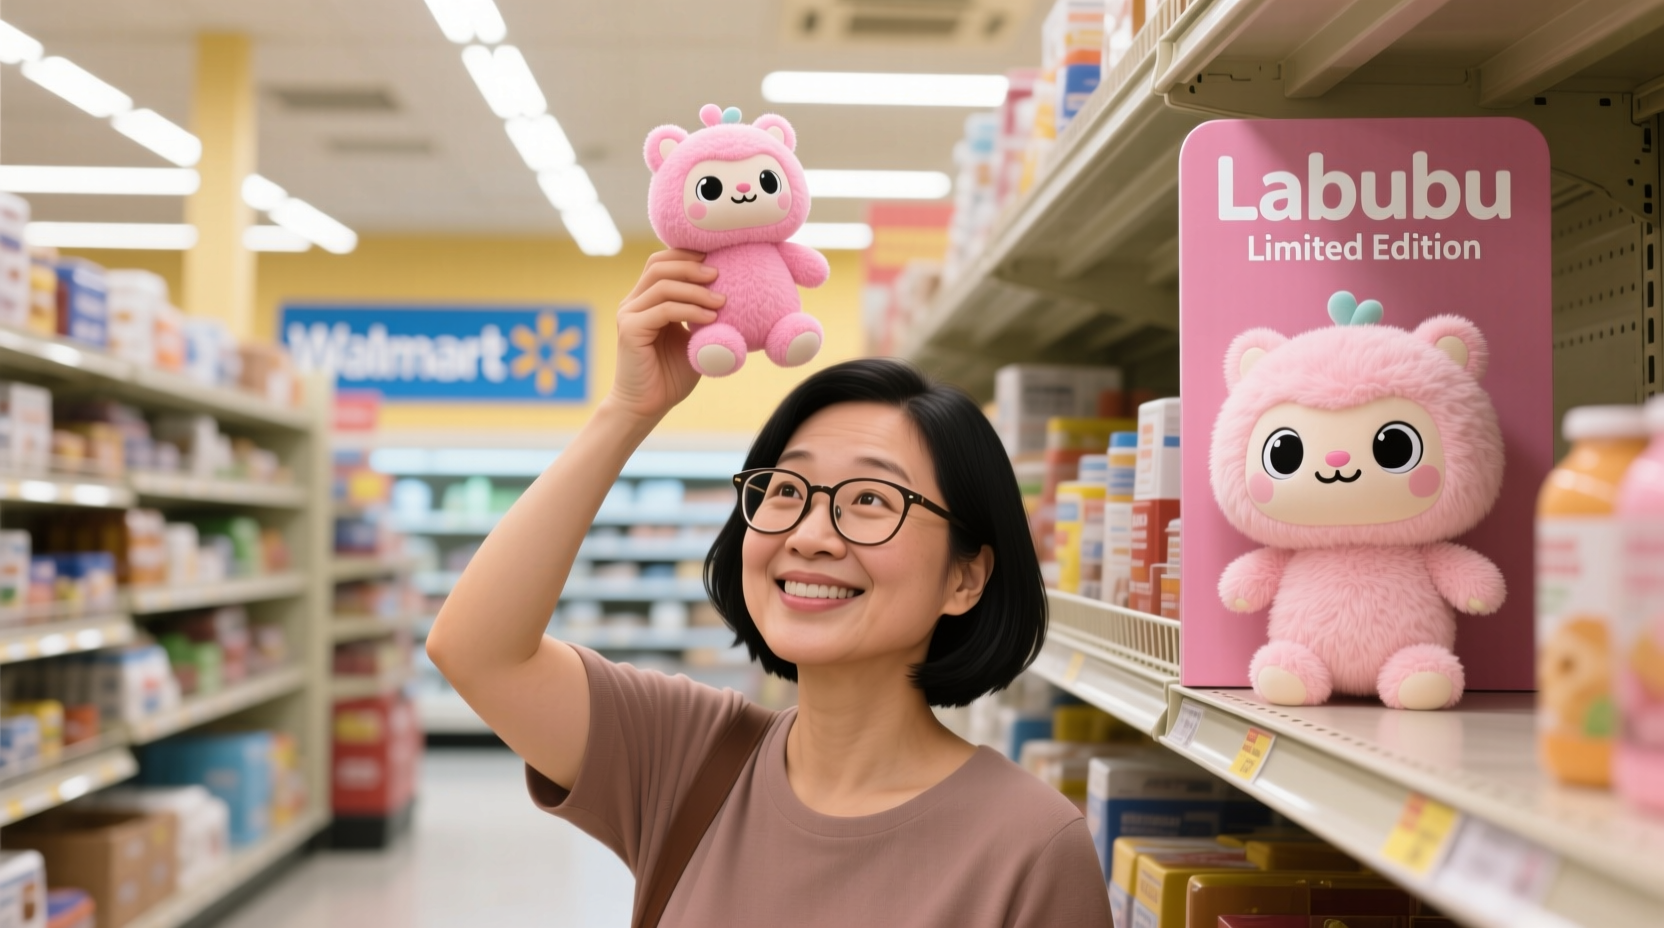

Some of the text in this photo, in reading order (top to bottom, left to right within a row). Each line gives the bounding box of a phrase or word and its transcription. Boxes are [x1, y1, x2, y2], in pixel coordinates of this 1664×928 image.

[1218, 151, 1512, 221] Labubu
[1248, 232, 1481, 261] Limited Edition
[287, 321, 508, 382] Walmart
